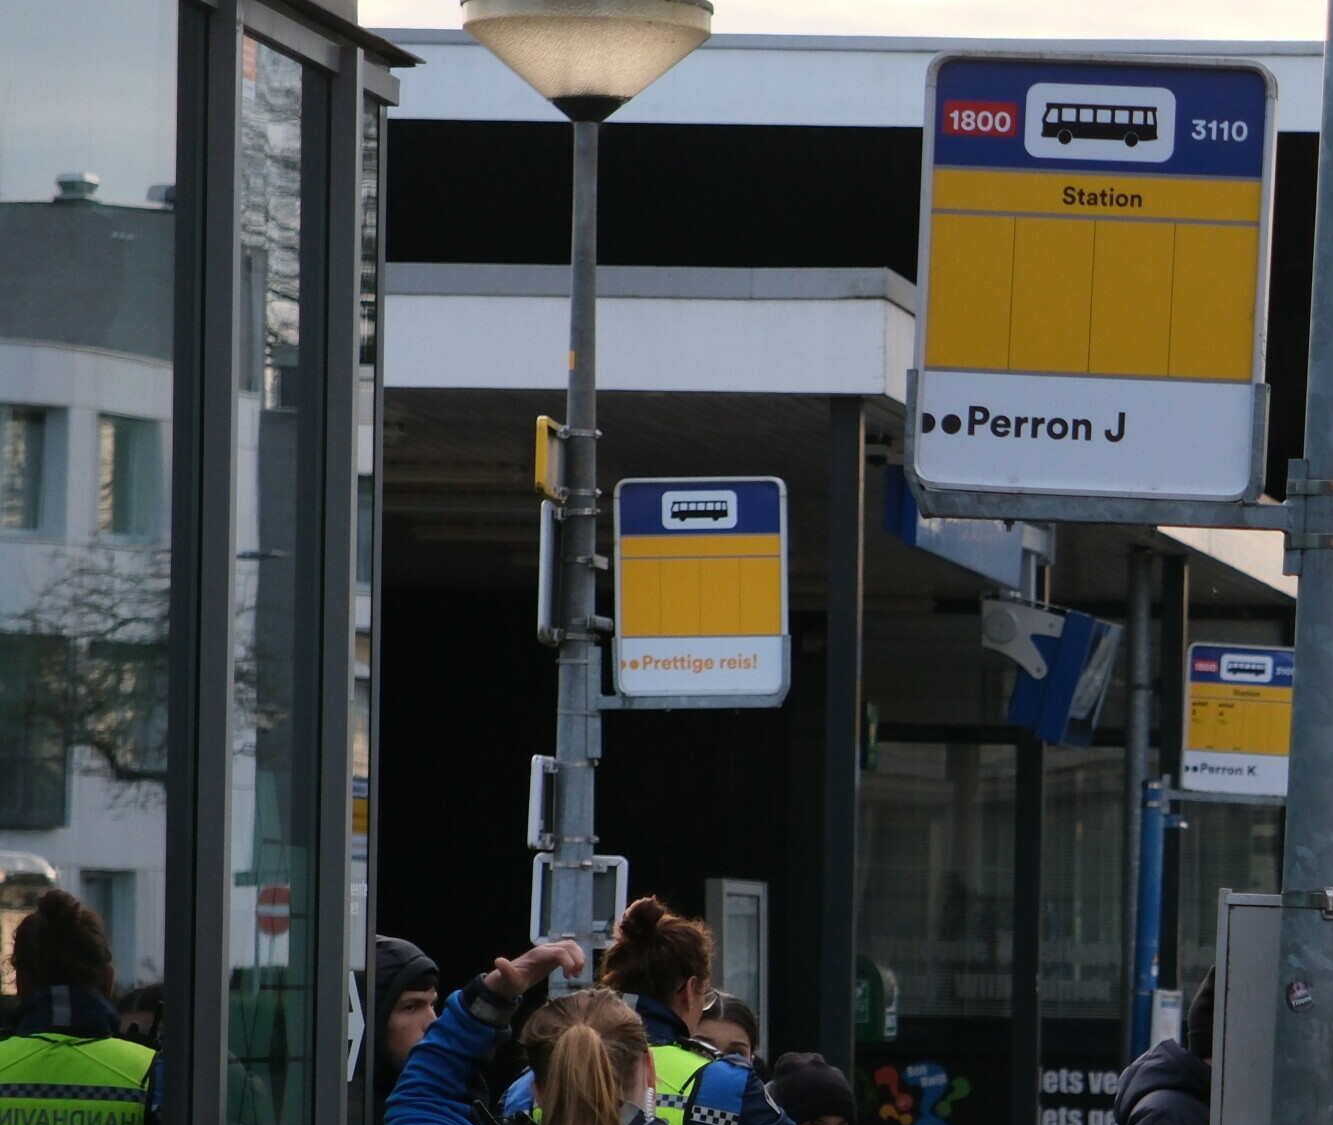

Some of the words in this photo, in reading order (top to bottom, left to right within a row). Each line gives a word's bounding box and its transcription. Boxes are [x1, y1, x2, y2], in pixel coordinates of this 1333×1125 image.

[949, 109, 1011, 133] 1800
[1191, 119, 1249, 142] 3110
[1062, 185, 1143, 208] Station
[967, 405, 1092, 441] Perron
[1104, 411, 1127, 443] J
[642, 654, 714, 676] Prettige
[719, 654, 758, 671] reis!
[1200, 763, 1243, 776] Perron
[1247, 765, 1257, 777] K
